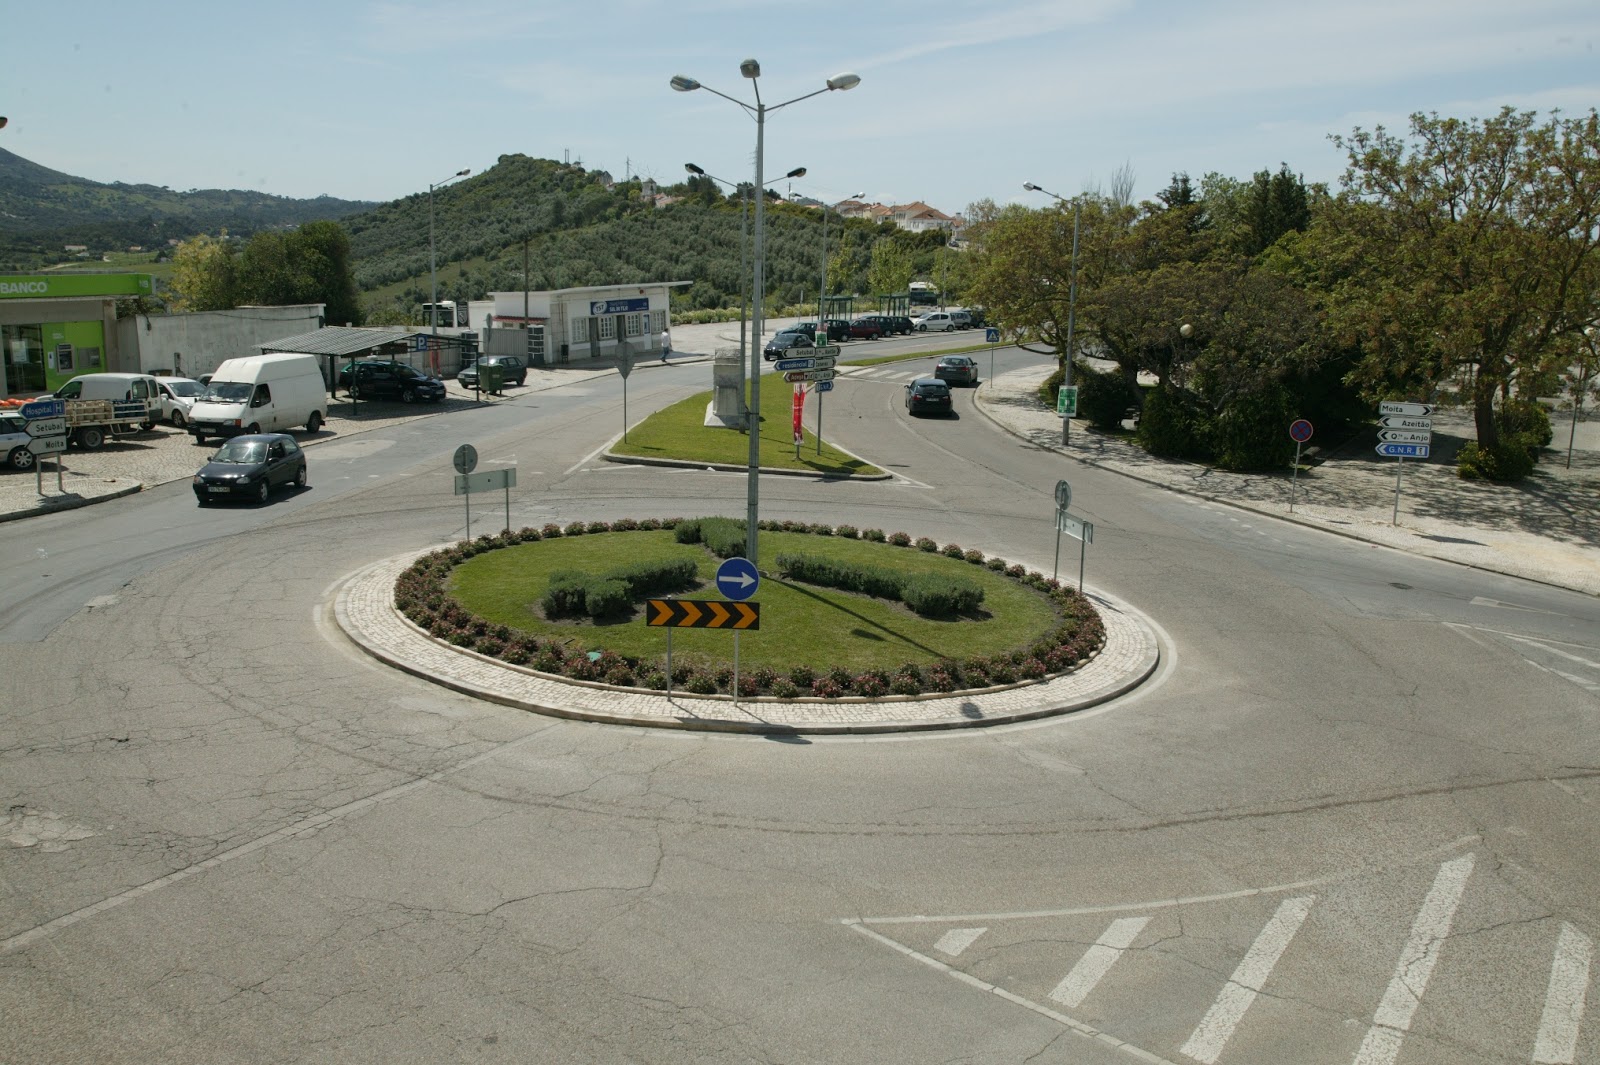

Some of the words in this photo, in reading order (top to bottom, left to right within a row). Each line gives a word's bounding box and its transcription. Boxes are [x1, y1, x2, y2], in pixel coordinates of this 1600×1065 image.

[0, 281, 48, 294] BANCO
[26, 405, 52, 415] Hospital
[45, 441, 65, 449] Moita
